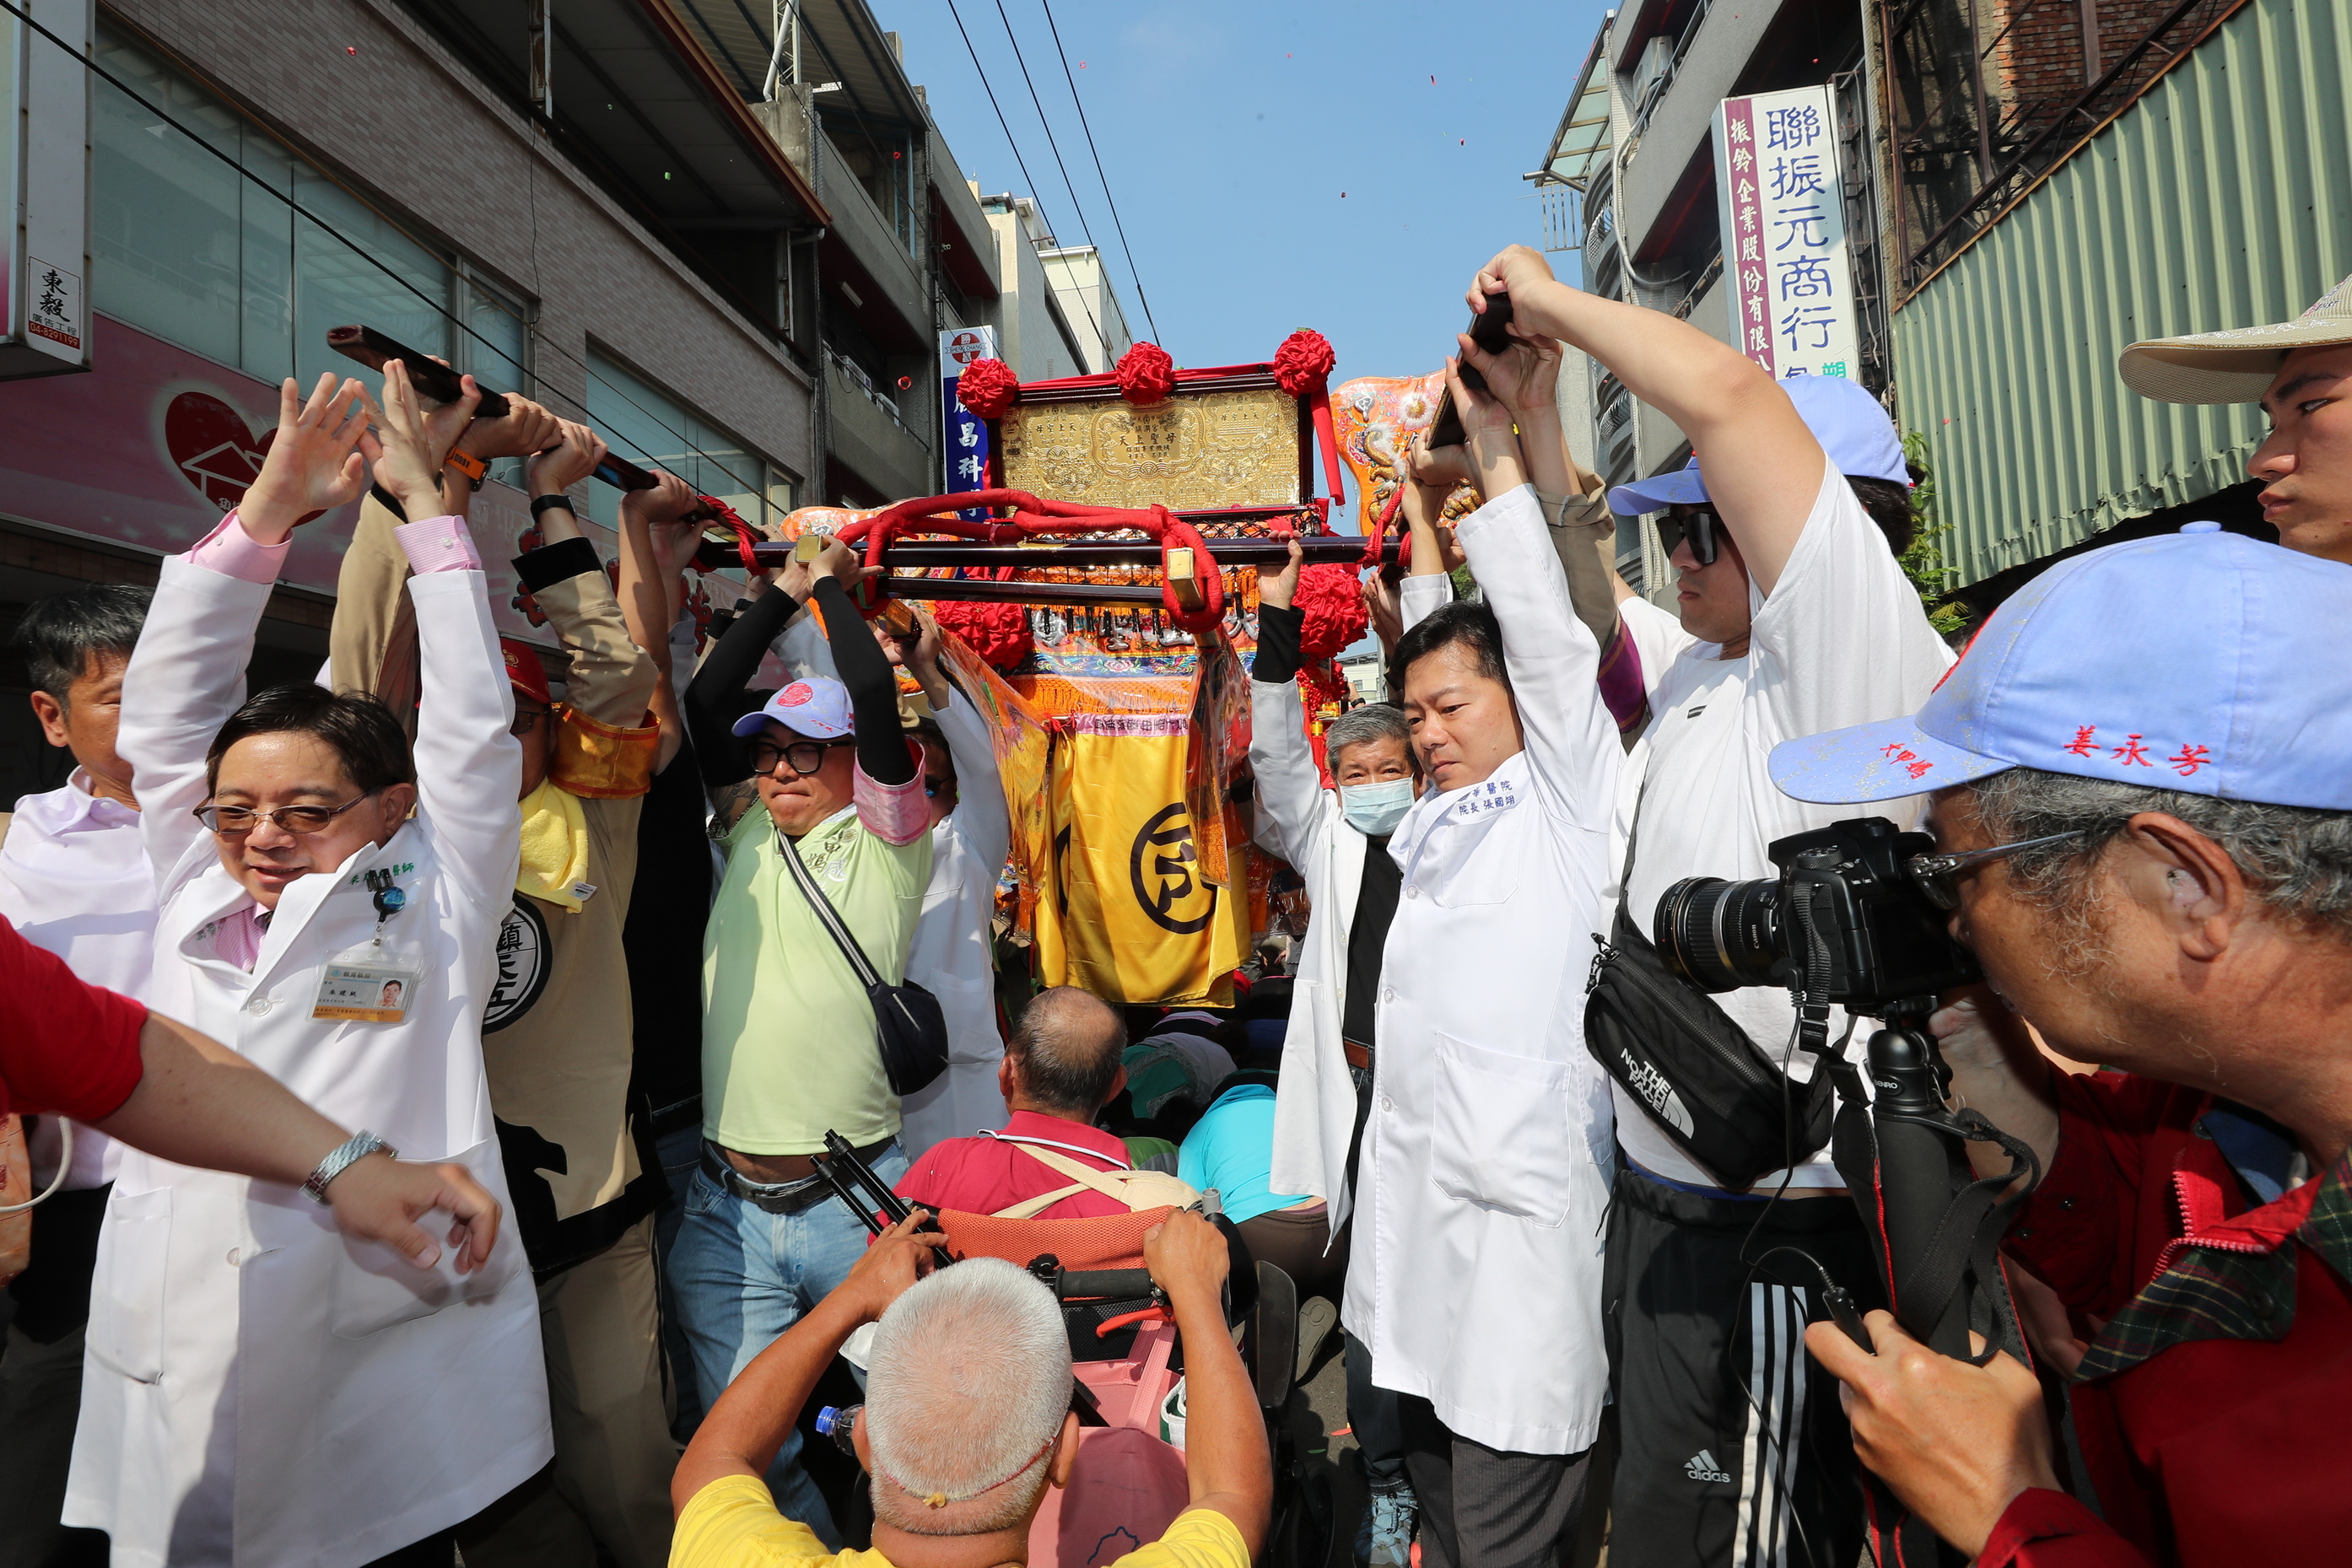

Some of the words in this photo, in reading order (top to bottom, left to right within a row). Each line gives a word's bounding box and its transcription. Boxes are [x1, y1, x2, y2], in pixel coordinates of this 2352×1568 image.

[1765, 105, 1837, 352] 聯振元商行
[30, 322, 79, 347] 04-8291199
[32, 313, 78, 337] 廣告工程
[1119, 433, 1177, 446] 天上聖母
[2063, 725, 2211, 776] 姜永芳
[1459, 802, 1480, 816] 院長
[1621, 1048, 1668, 1107] NORTH
[1629, 1074, 1664, 1113] FACE
[1643, 1060, 1672, 1095] THE
